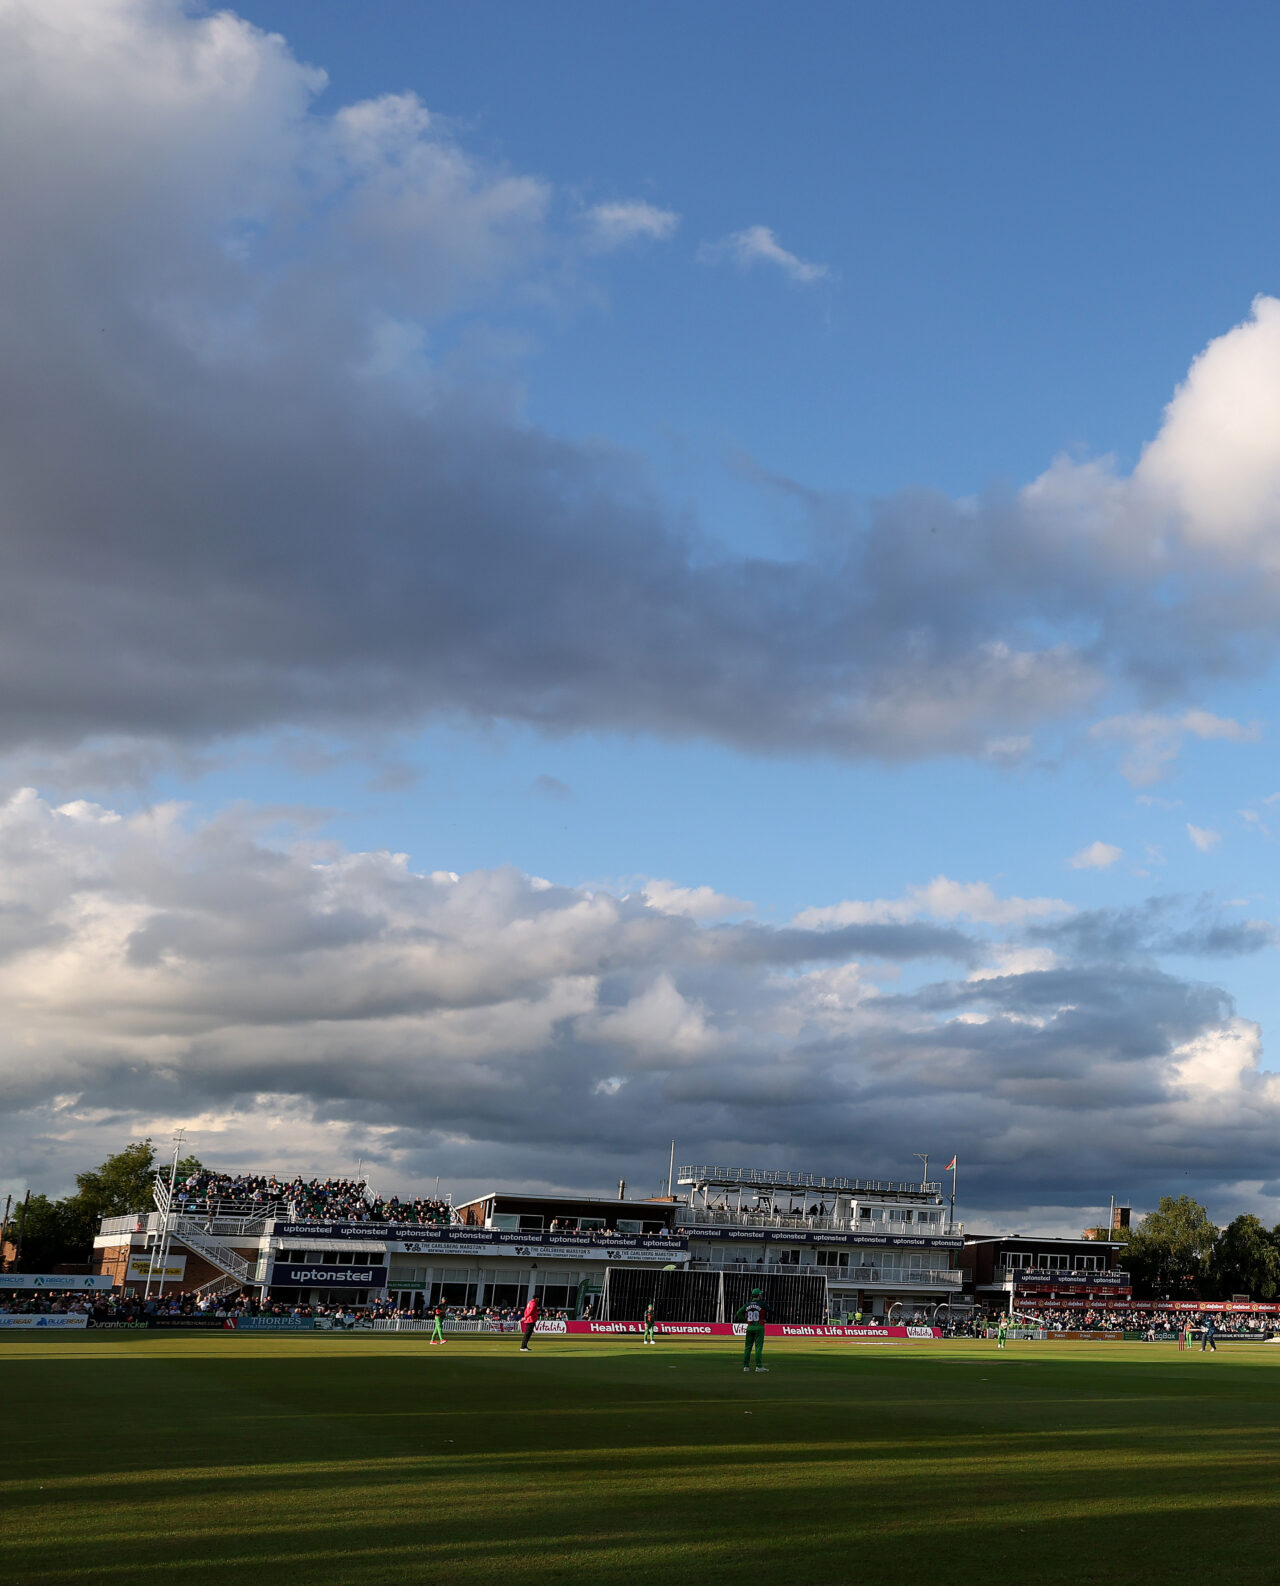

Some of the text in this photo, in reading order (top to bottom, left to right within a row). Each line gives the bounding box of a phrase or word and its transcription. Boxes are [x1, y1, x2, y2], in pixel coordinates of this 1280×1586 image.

[283, 1225, 681, 1248] uptonsteel uptonsteel uptonsteel uptonsteel uptonsteel uptonsteel uptonsteel uptonsteel
[684, 1229, 721, 1237] uptonsteel
[771, 1232, 807, 1240] uptonsteel
[813, 1234, 847, 1242] uptonsteel
[854, 1236, 887, 1244] uptonsteel
[291, 1269, 373, 1282] uptonsteel
[251, 1317, 302, 1325] THORPES
[747, 1310, 760, 1322] 80
[534, 1320, 565, 1333] Vitality
[590, 1323, 624, 1332] Health
[625, 1324, 636, 1332] &
[639, 1324, 658, 1333] Lie
[662, 1324, 711, 1334] insurance
[782, 1326, 814, 1335] Health
[815, 1326, 823, 1335] &
[824, 1327, 843, 1336] Life
[844, 1327, 888, 1336] insurance
[908, 1327, 932, 1338] Vitality
[1154, 1332, 1176, 1340] ogBox
